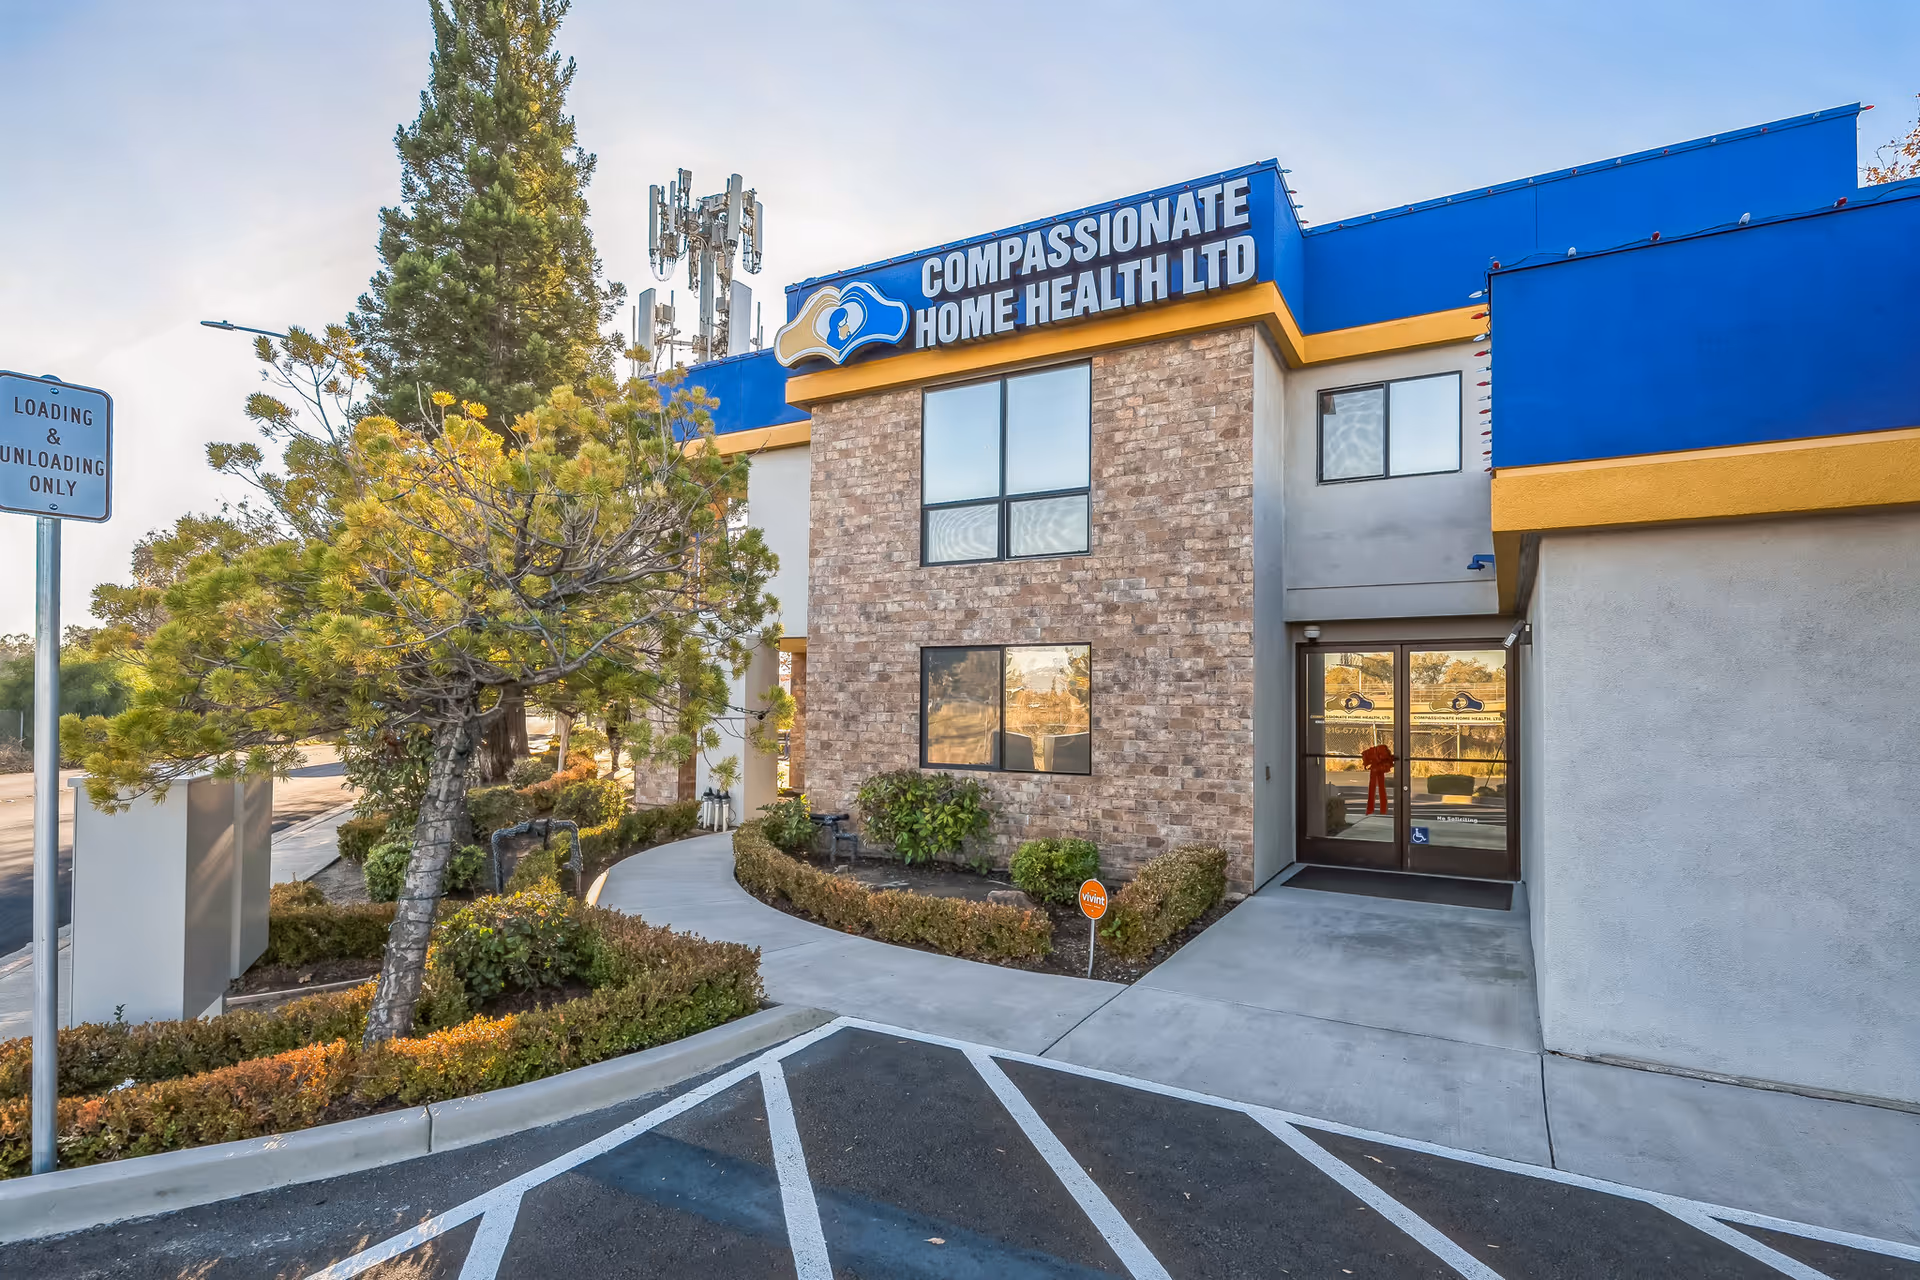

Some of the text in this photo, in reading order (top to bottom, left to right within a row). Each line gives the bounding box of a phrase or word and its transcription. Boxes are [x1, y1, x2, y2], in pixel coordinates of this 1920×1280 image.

[921, 176, 1252, 299] COMPASSIONATE
[915, 234, 1257, 350] HOME HEALTH LTD
[14, 396, 93, 426] LOADING
[46, 428, 61, 445] &
[0, 445, 105, 476] UNLOADING
[29, 475, 77, 496] ONLY
[1447, 816, 1478, 824] Soliciting
[1082, 892, 1105, 906] vivint
